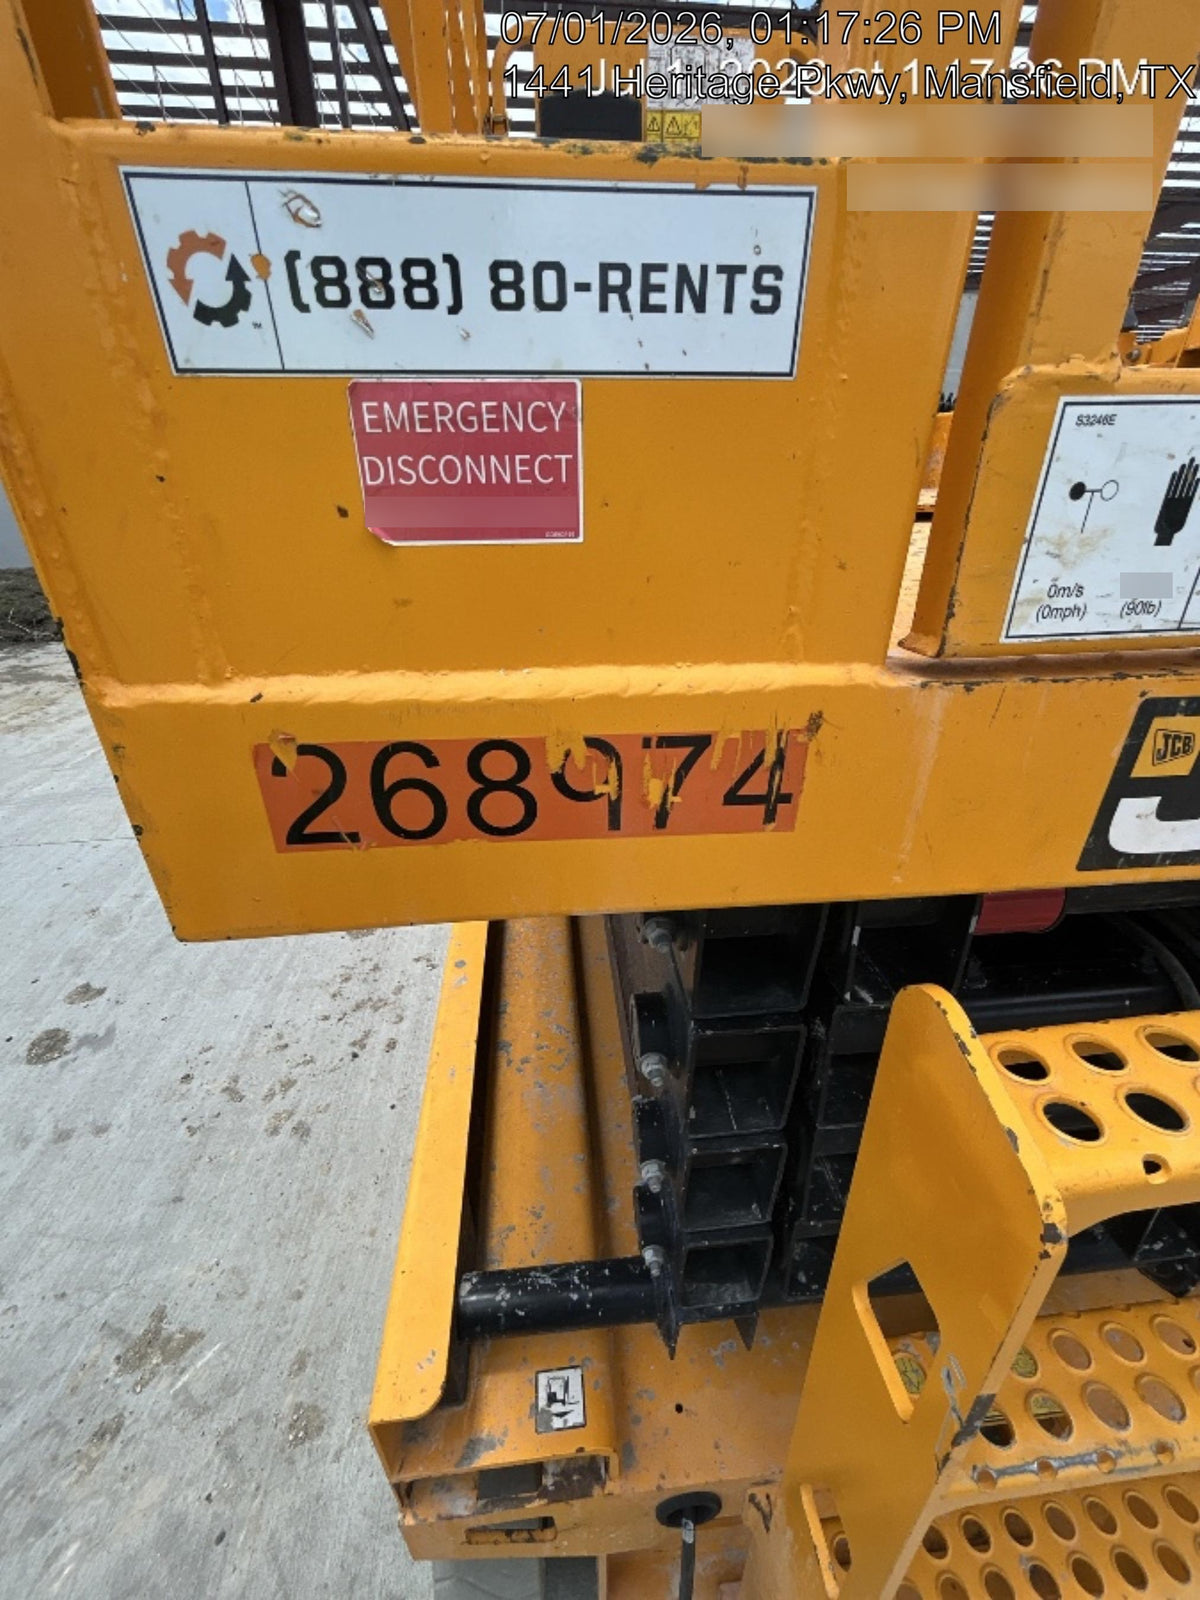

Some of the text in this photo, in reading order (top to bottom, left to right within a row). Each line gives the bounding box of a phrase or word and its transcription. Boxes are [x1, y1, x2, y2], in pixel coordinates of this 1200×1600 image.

[284, 249, 785, 316] (888) 80-RENTS
[361, 400, 567, 434] EMERGENCY
[362, 453, 574, 487] DISCONNECT
[1046, 582, 1085, 599] 0m/s
[1036, 602, 1088, 623] (0mph)
[1119, 599, 1162, 620] (90lb)
[1155, 731, 1193, 763] JCB
[271, 734, 793, 845] 268974
